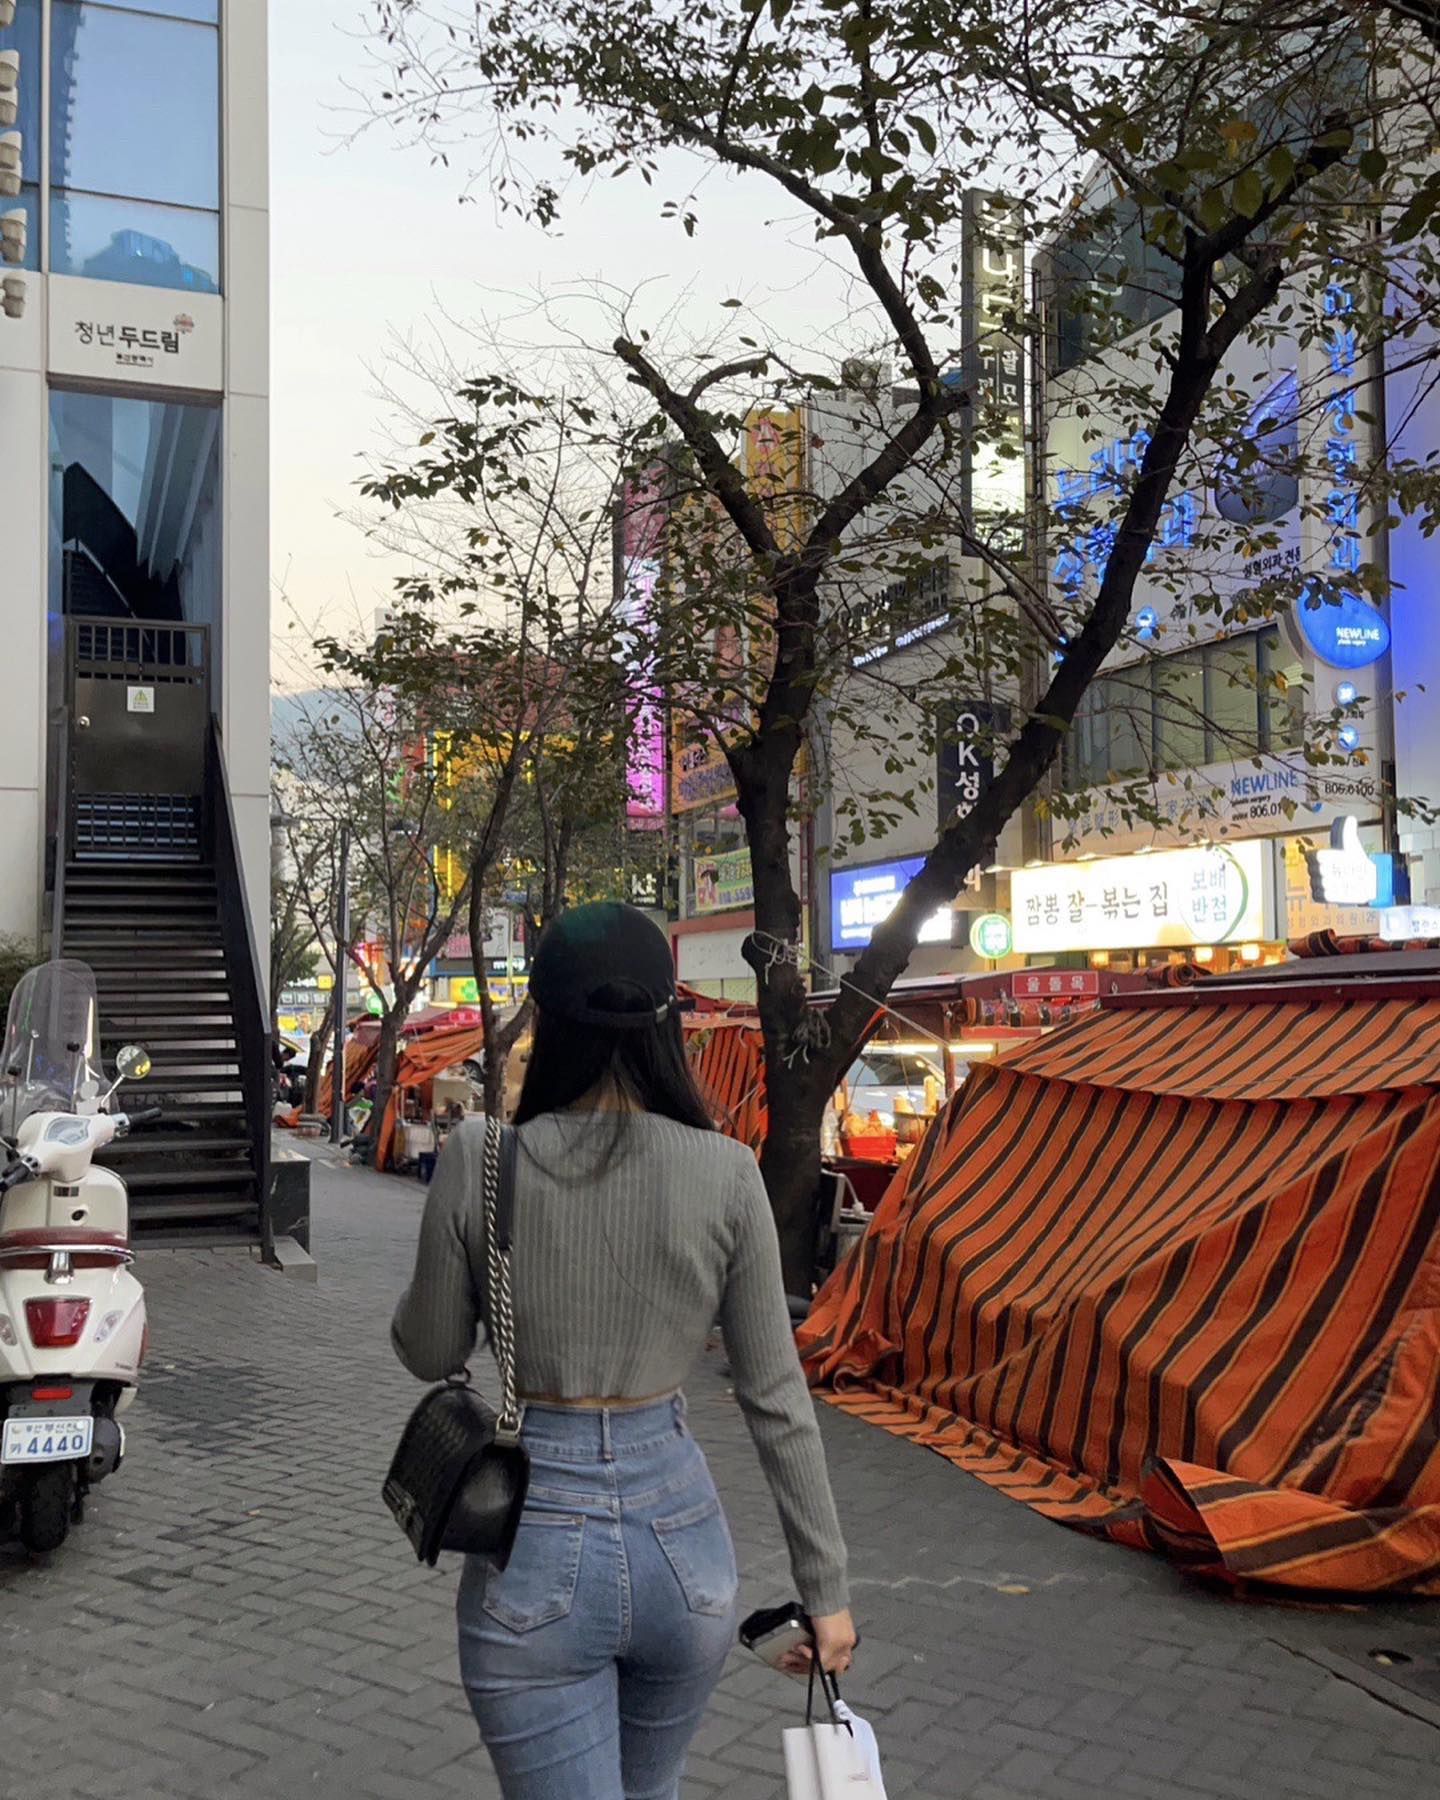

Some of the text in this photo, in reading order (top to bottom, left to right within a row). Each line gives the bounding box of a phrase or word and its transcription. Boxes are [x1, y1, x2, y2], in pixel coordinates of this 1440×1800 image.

[1335, 626, 1381, 641] NEWLINE
[1230, 769, 1298, 796] NEWLINE
[1191, 864, 1227, 892] 보배
[1025, 892, 1060, 926] 짬뽕
[1149, 881, 1169, 917] 집
[1191, 895, 1228, 924] 반점
[27, 1435, 83, 1454] 4440
